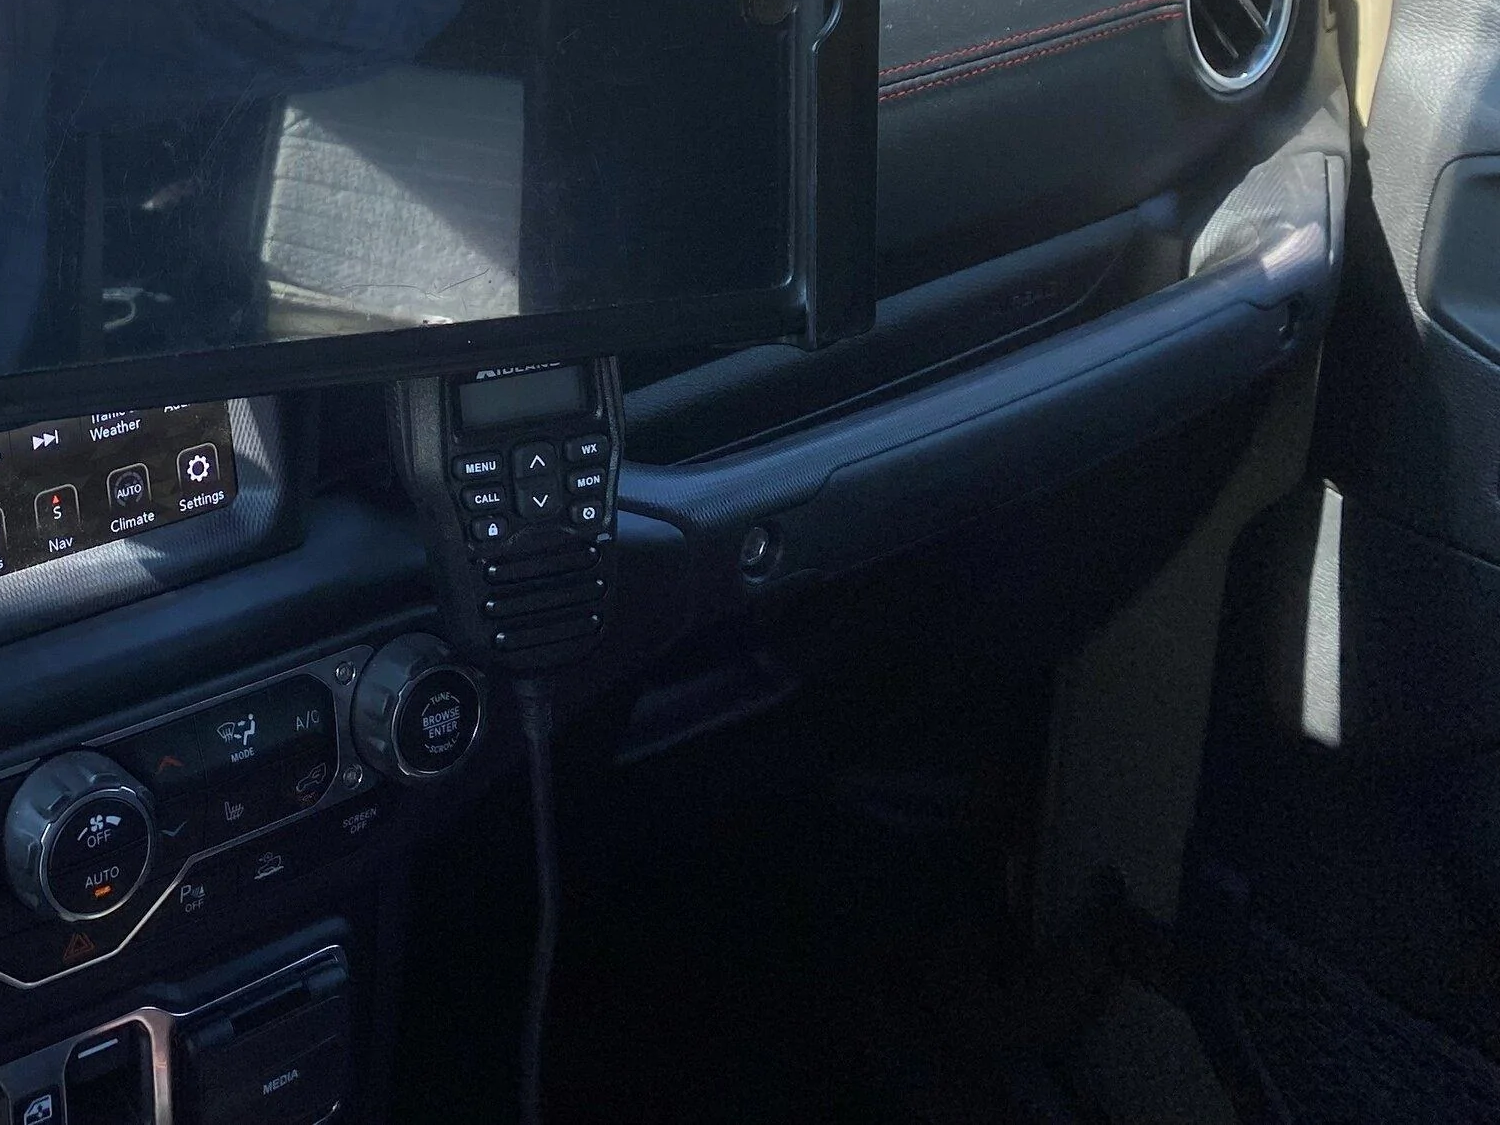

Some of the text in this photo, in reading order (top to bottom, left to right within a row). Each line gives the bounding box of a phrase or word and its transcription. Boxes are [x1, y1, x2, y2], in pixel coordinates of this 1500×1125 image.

[89, 418, 141, 442] Weather
[581, 443, 598, 455] WX
[465, 460, 496, 474] MENU
[577, 475, 601, 488] MON
[117, 484, 142, 498] AUTO
[474, 492, 501, 505] CALL
[178, 489, 225, 513] Settings
[53, 507, 62, 520] S
[110, 511, 155, 534] Climate
[48, 537, 74, 553] Nav
[295, 710, 320, 731] A/C
[422, 706, 460, 727] BROWSE
[428, 721, 458, 739] ENTER
[231, 747, 255, 764] MODE
[87, 830, 112, 848] OFF
[84, 866, 120, 889] AUTO
[185, 900, 204, 913] OFF
[263, 1069, 299, 1096] MEDIA
